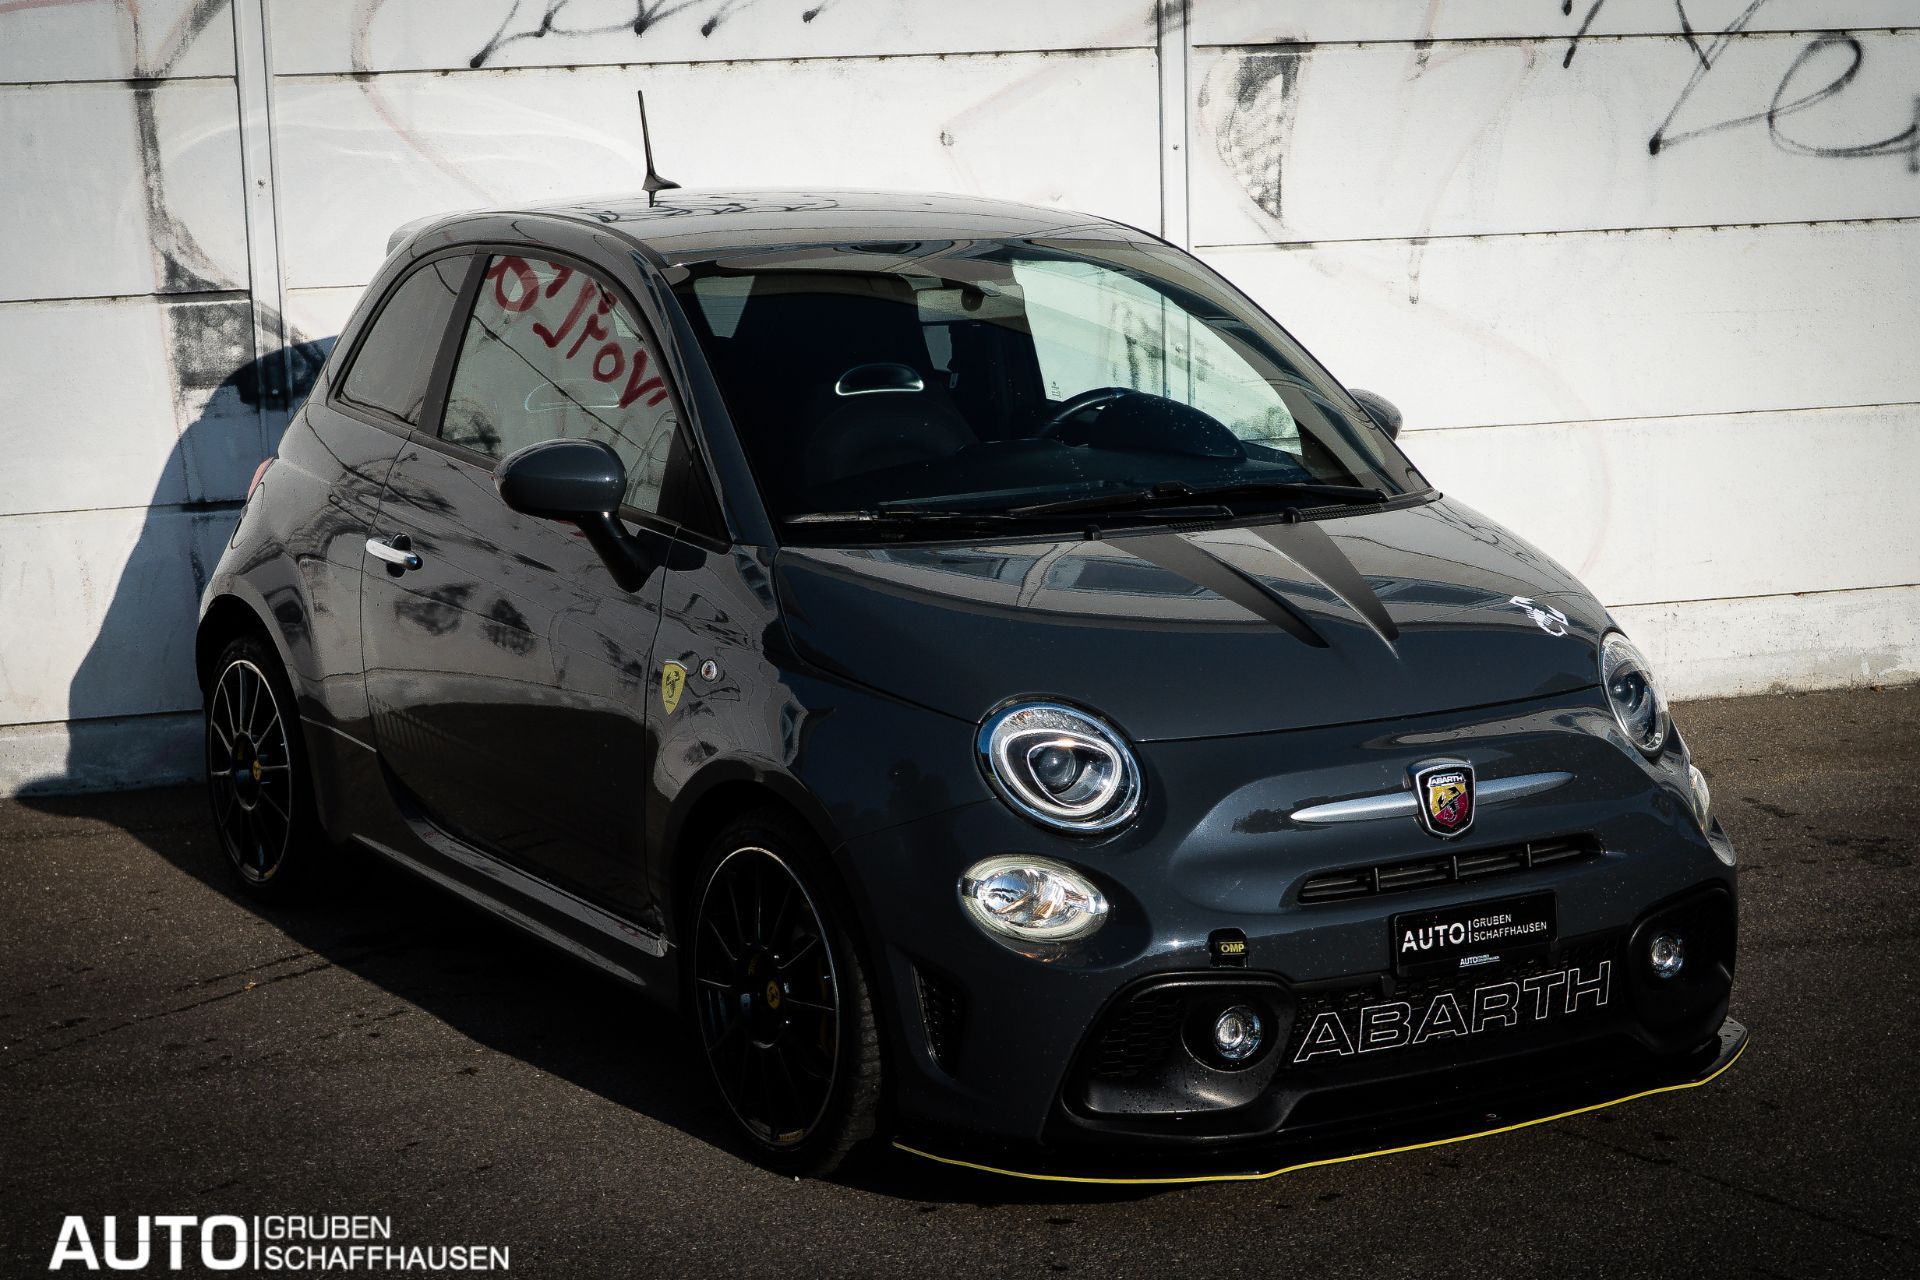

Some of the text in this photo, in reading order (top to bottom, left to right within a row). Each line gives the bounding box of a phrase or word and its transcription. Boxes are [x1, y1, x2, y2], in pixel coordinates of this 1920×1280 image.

[1431, 775, 1463, 785] ABARTH
[1472, 913, 1512, 929] GRUBEN
[1401, 922, 1465, 953] AUTO
[1473, 921, 1548, 942] SCHAFFHAUSEN
[1220, 943, 1245, 953] OMP
[1460, 956, 1478, 966] AUTO
[1294, 961, 1611, 1063] ABARTH
